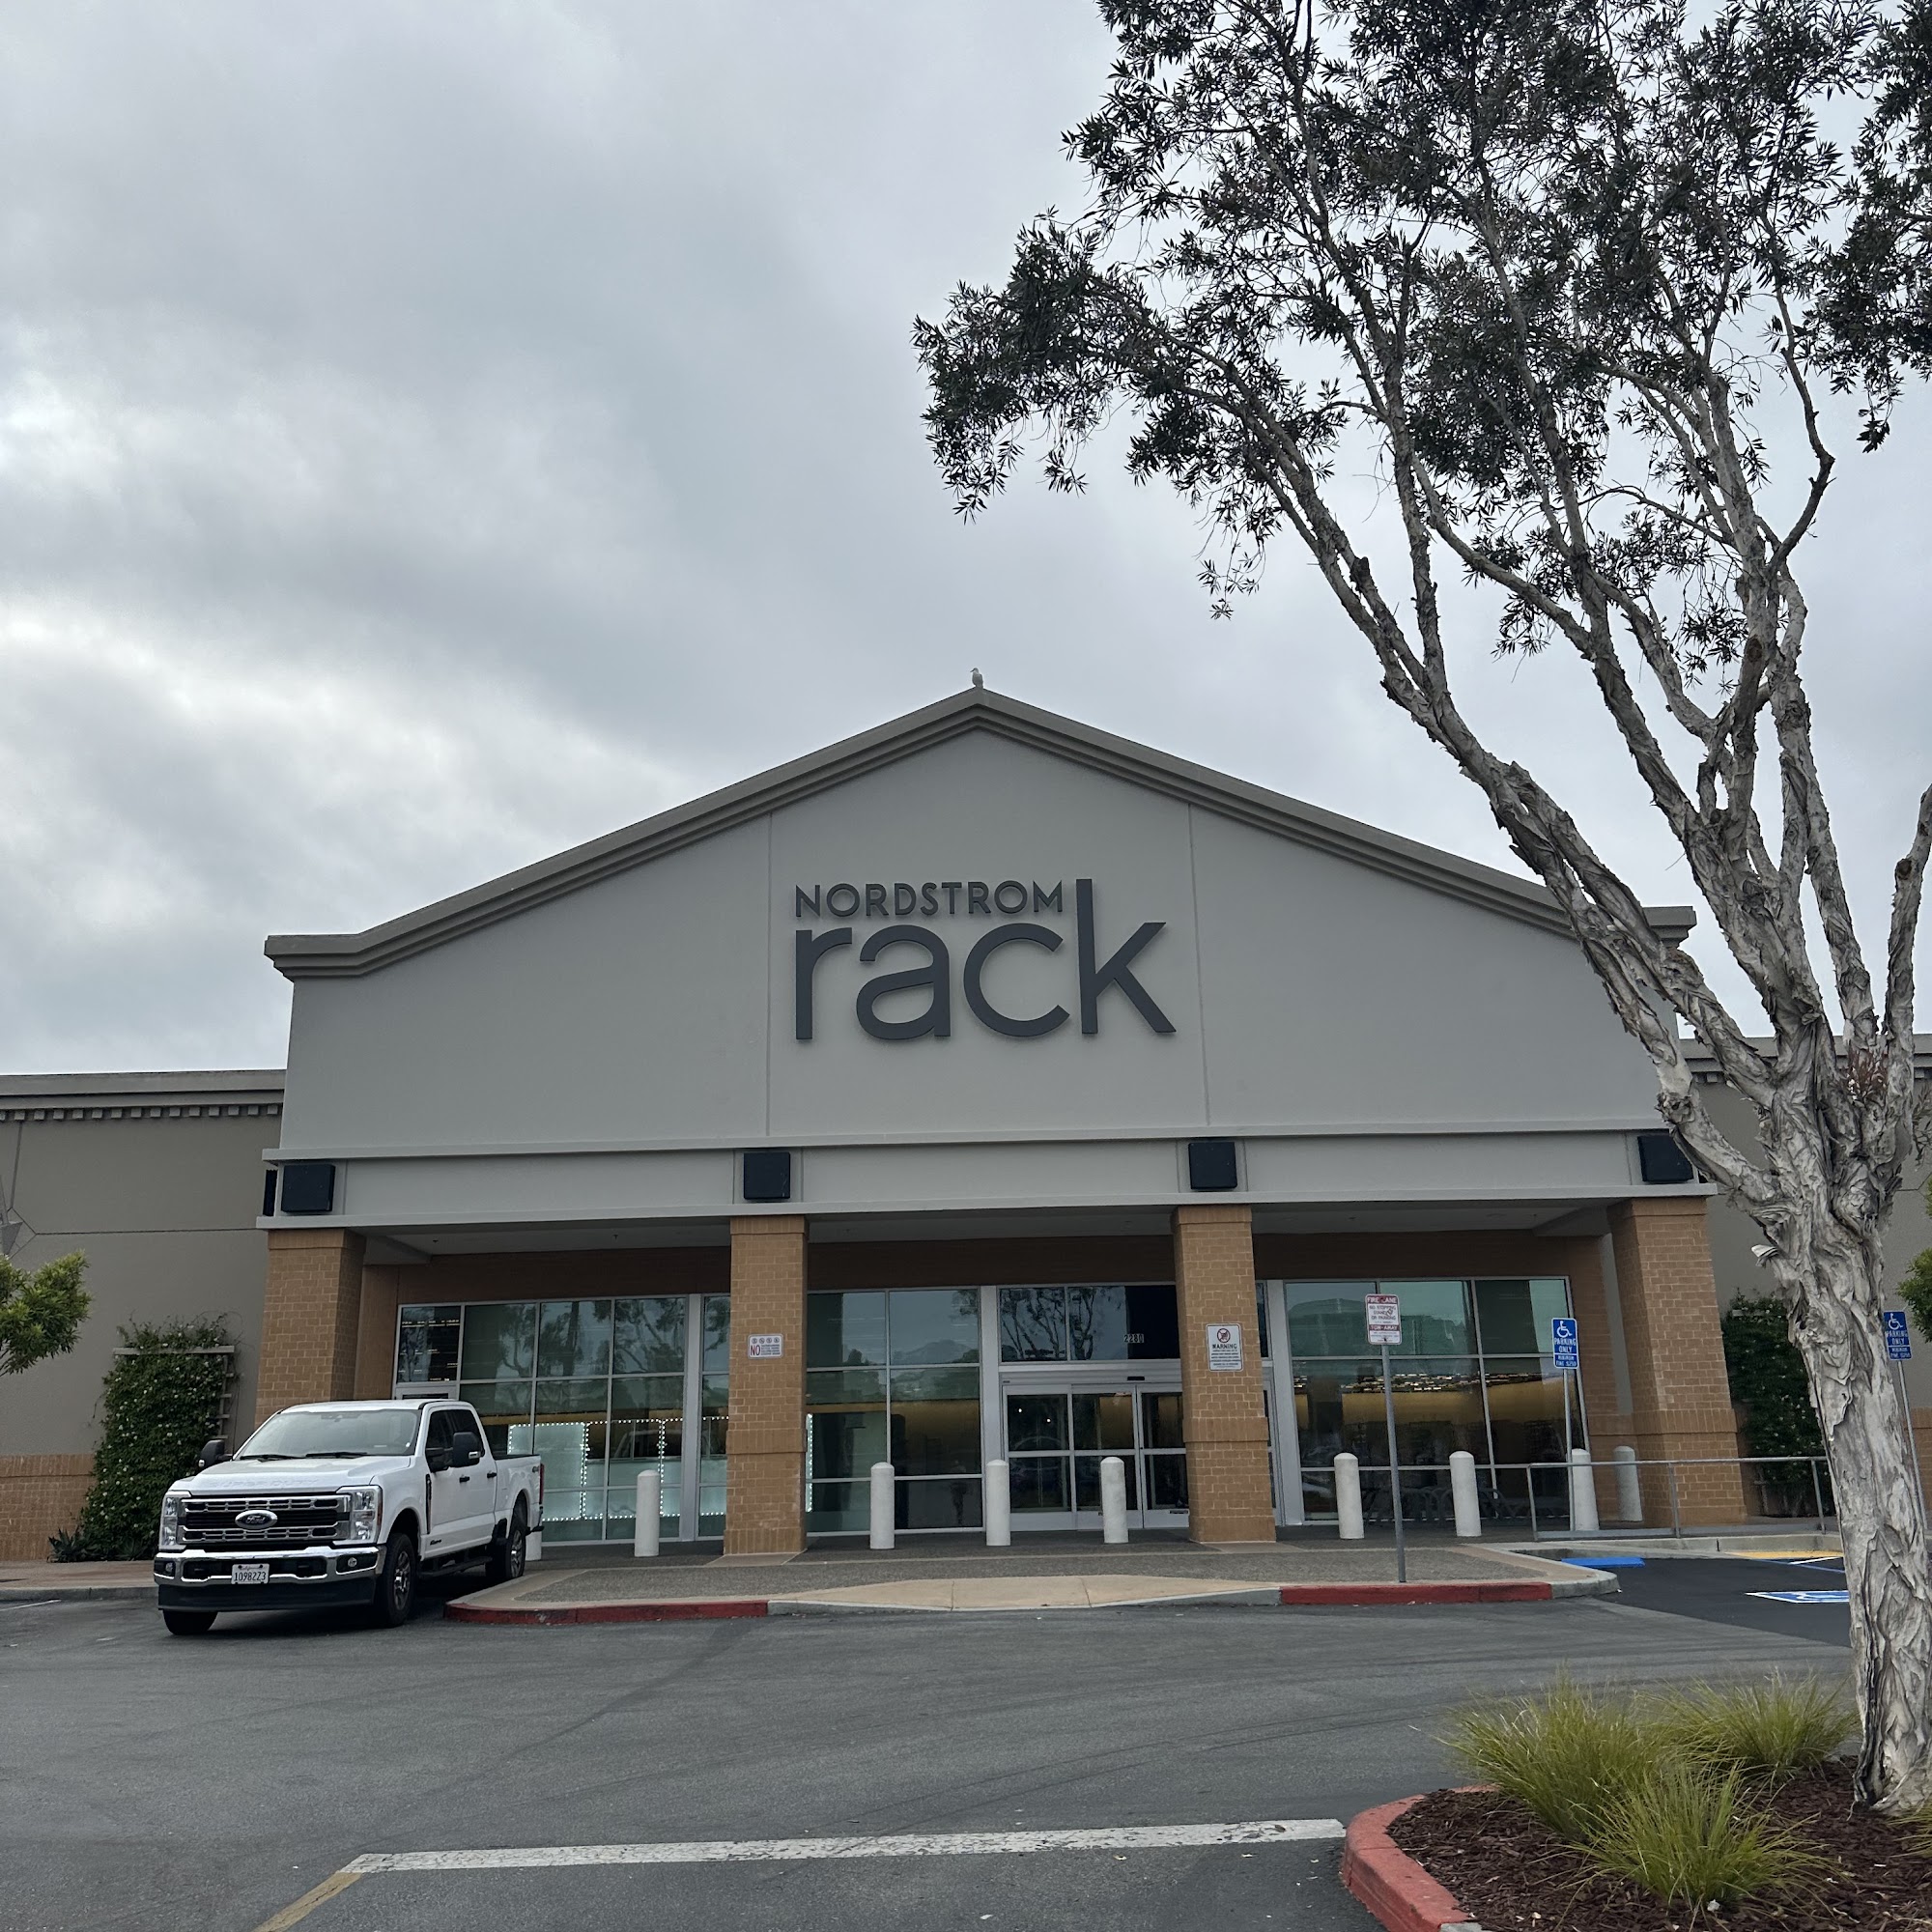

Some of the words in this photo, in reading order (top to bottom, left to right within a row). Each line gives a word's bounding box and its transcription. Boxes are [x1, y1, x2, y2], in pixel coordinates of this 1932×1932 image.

[796, 879, 1063, 918] NORDSTROM
[795, 878, 1177, 1040] rack
[750, 1345, 761, 1356] NO
